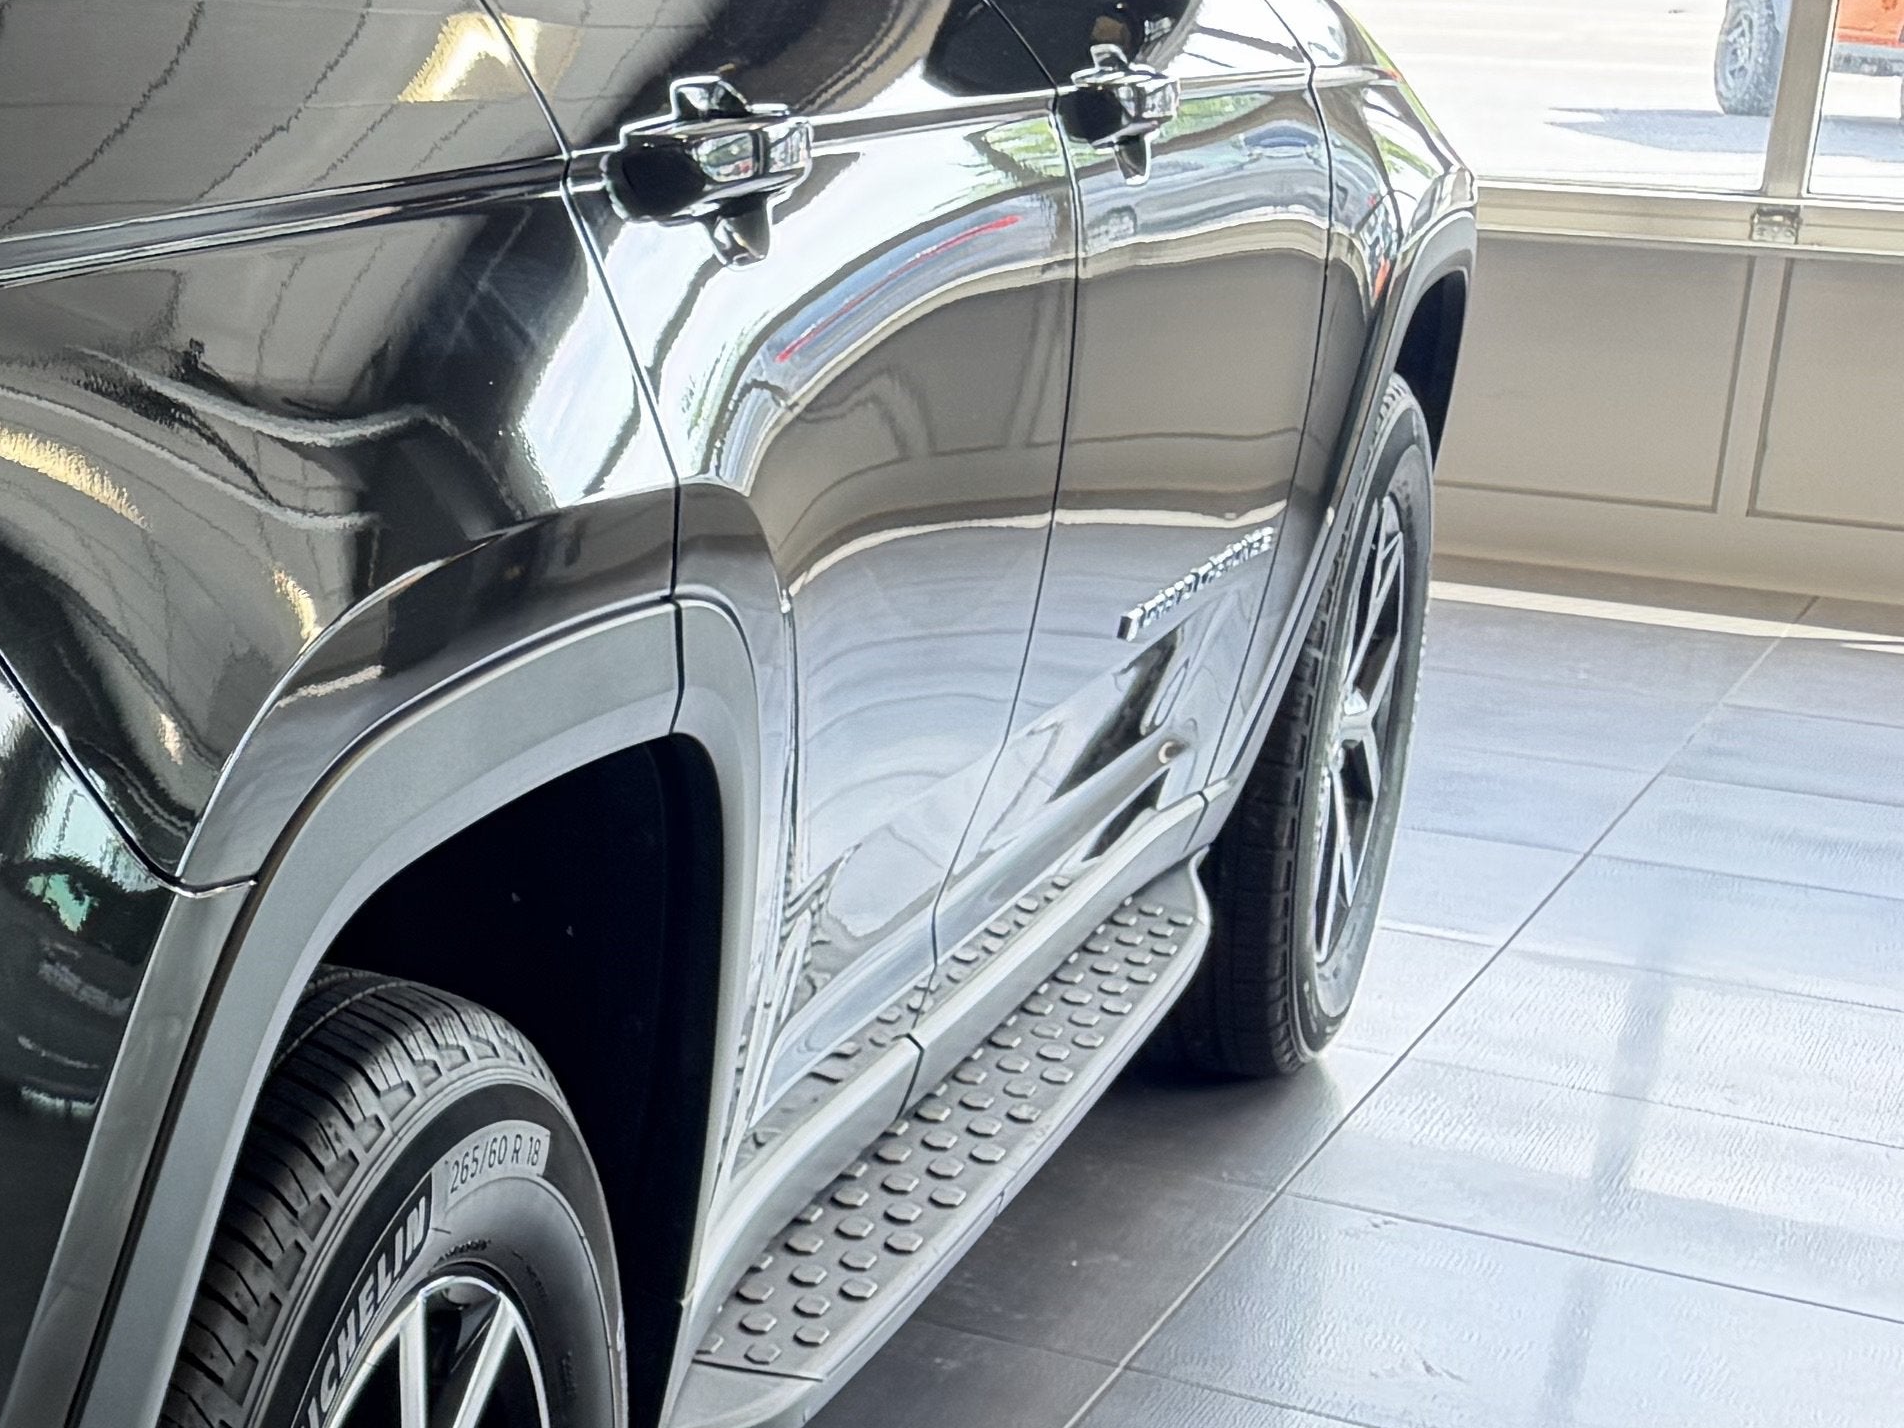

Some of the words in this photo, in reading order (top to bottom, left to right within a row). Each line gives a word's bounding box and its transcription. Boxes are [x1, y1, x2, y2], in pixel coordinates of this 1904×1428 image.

[449, 1134, 508, 1194] 265/60
[511, 1133, 523, 1165] R
[527, 1135, 541, 1166] 18
